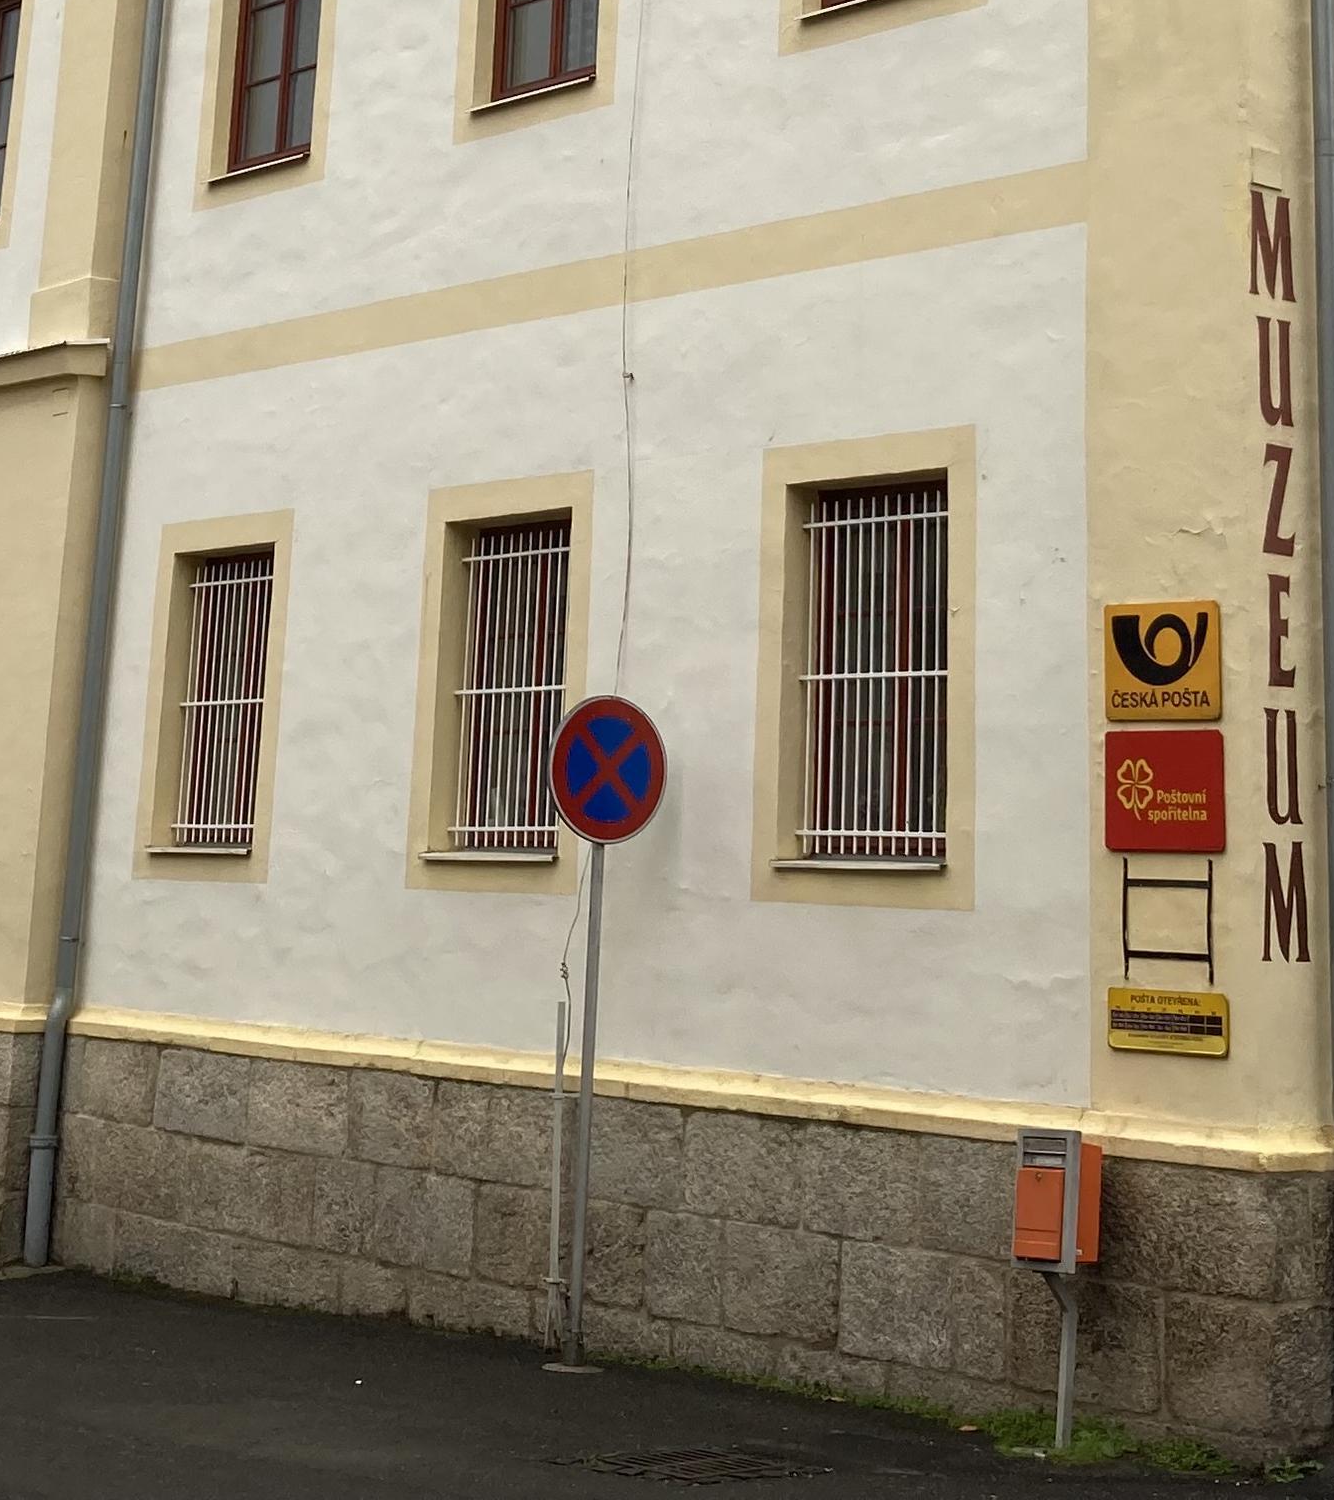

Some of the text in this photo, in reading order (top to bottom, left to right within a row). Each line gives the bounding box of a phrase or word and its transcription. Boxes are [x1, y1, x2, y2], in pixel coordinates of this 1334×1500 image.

[1249, 191, 1311, 962] MUZEUM
[1111, 688, 1210, 708] ČESKÁ POŠTA
[1157, 789, 1207, 804] Poštovní
[1148, 807, 1208, 825] spořitelna
